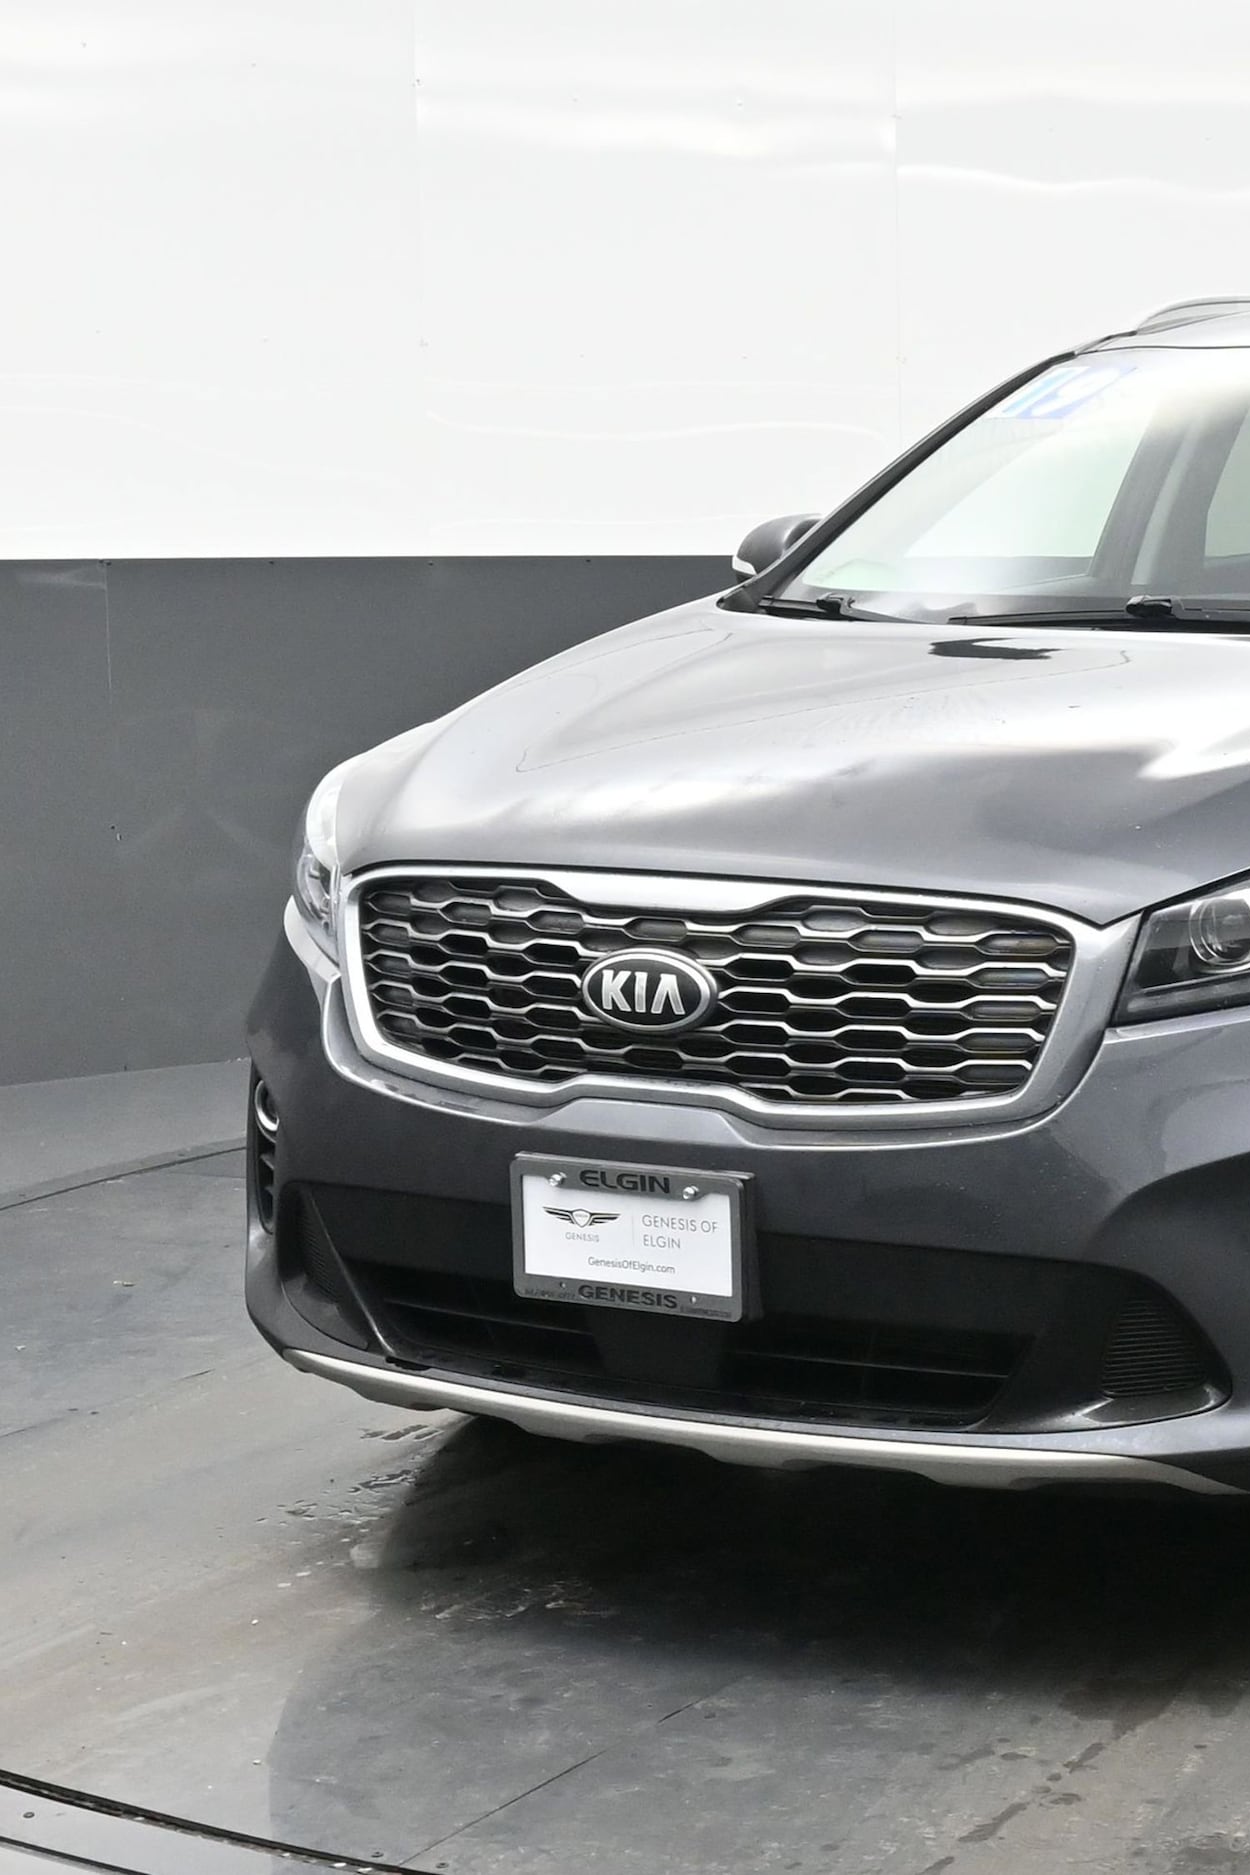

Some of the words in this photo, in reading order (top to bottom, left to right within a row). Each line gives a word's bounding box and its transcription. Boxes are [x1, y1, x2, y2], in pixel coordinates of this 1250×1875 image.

[602, 969, 685, 1015] KIA
[580, 1170, 670, 1194] ELGIN
[642, 1214, 697, 1232] GENESIS
[701, 1220, 718, 1233] OF
[565, 1231, 600, 1243] GENESIS
[643, 1235, 681, 1249] ELGIN
[588, 1256, 676, 1275] GenesisOfElgin.com
[578, 1284, 677, 1309] GENESIS
